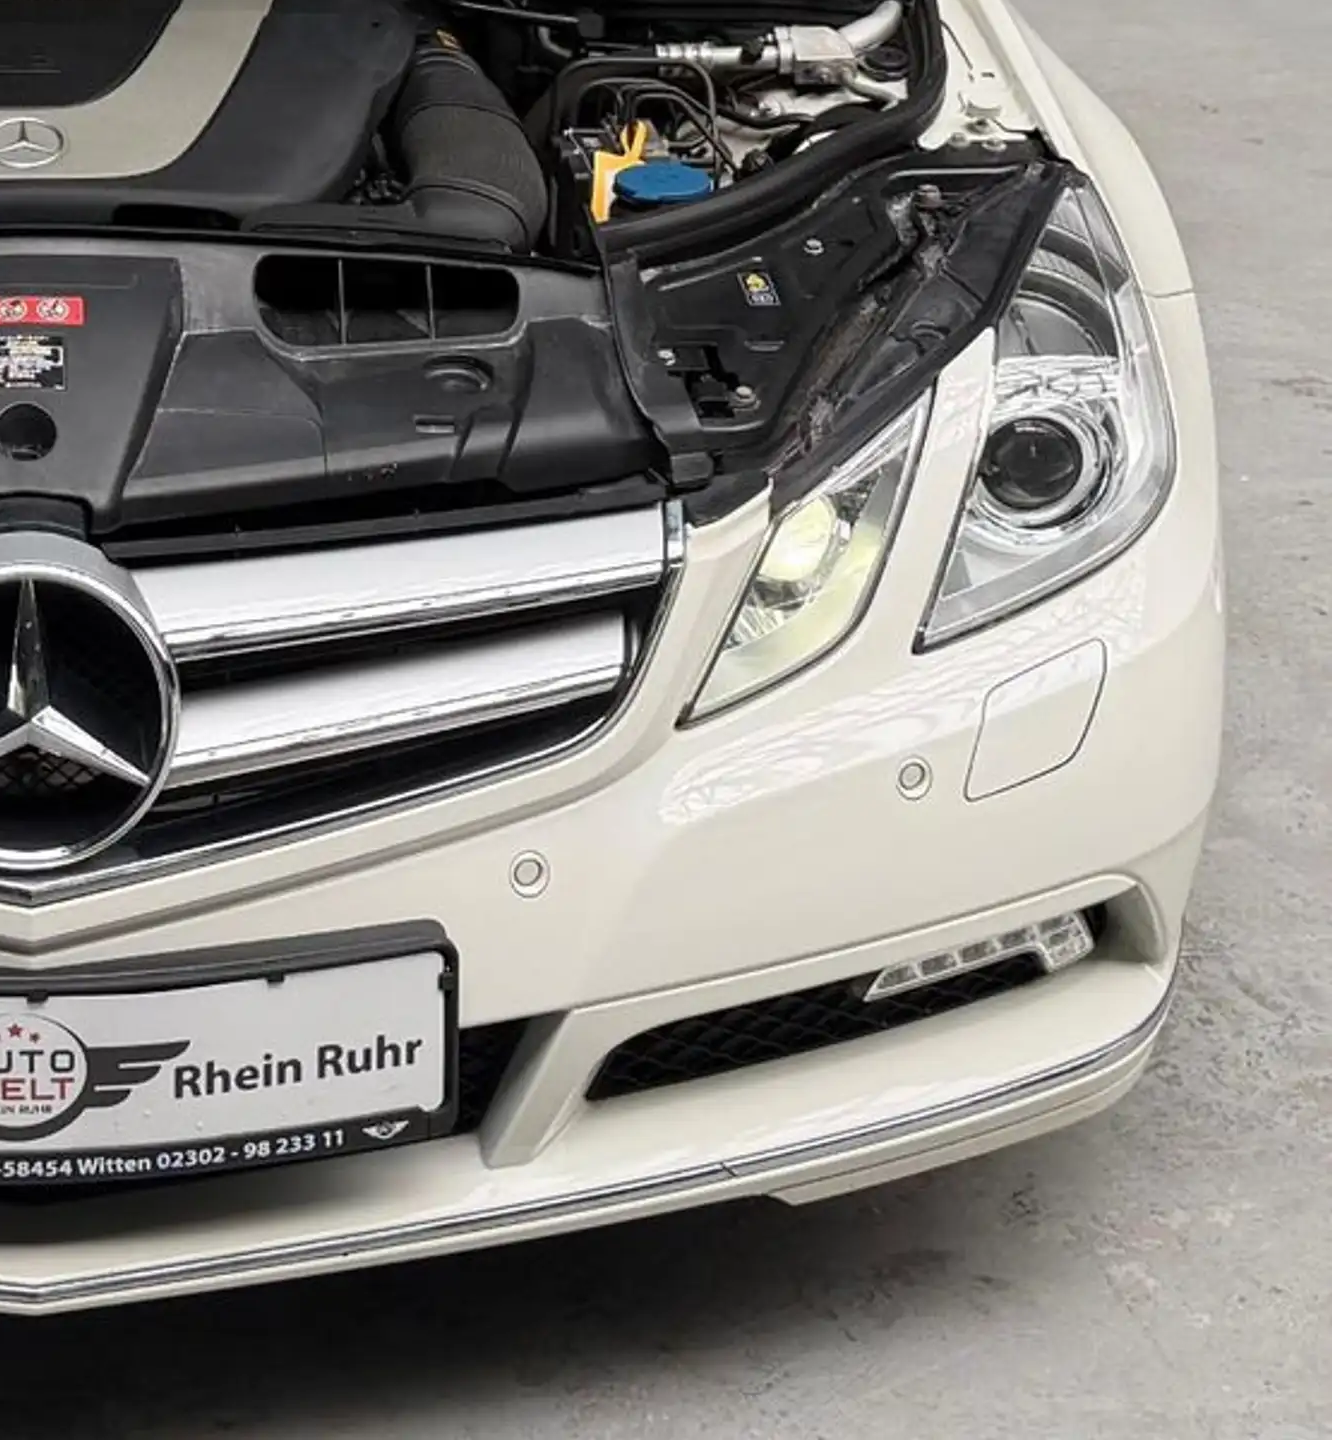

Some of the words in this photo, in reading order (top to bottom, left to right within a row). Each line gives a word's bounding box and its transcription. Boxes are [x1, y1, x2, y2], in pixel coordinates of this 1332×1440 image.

[174, 1053, 302, 1099] Rhein
[317, 1035, 423, 1079] Ruhr
[76, 1156, 151, 1175] Witten
[156, 1147, 226, 1169] 02302
[244, 1140, 270, 1160] 98
[275, 1133, 316, 1155] 233
[323, 1129, 344, 1148] 11
